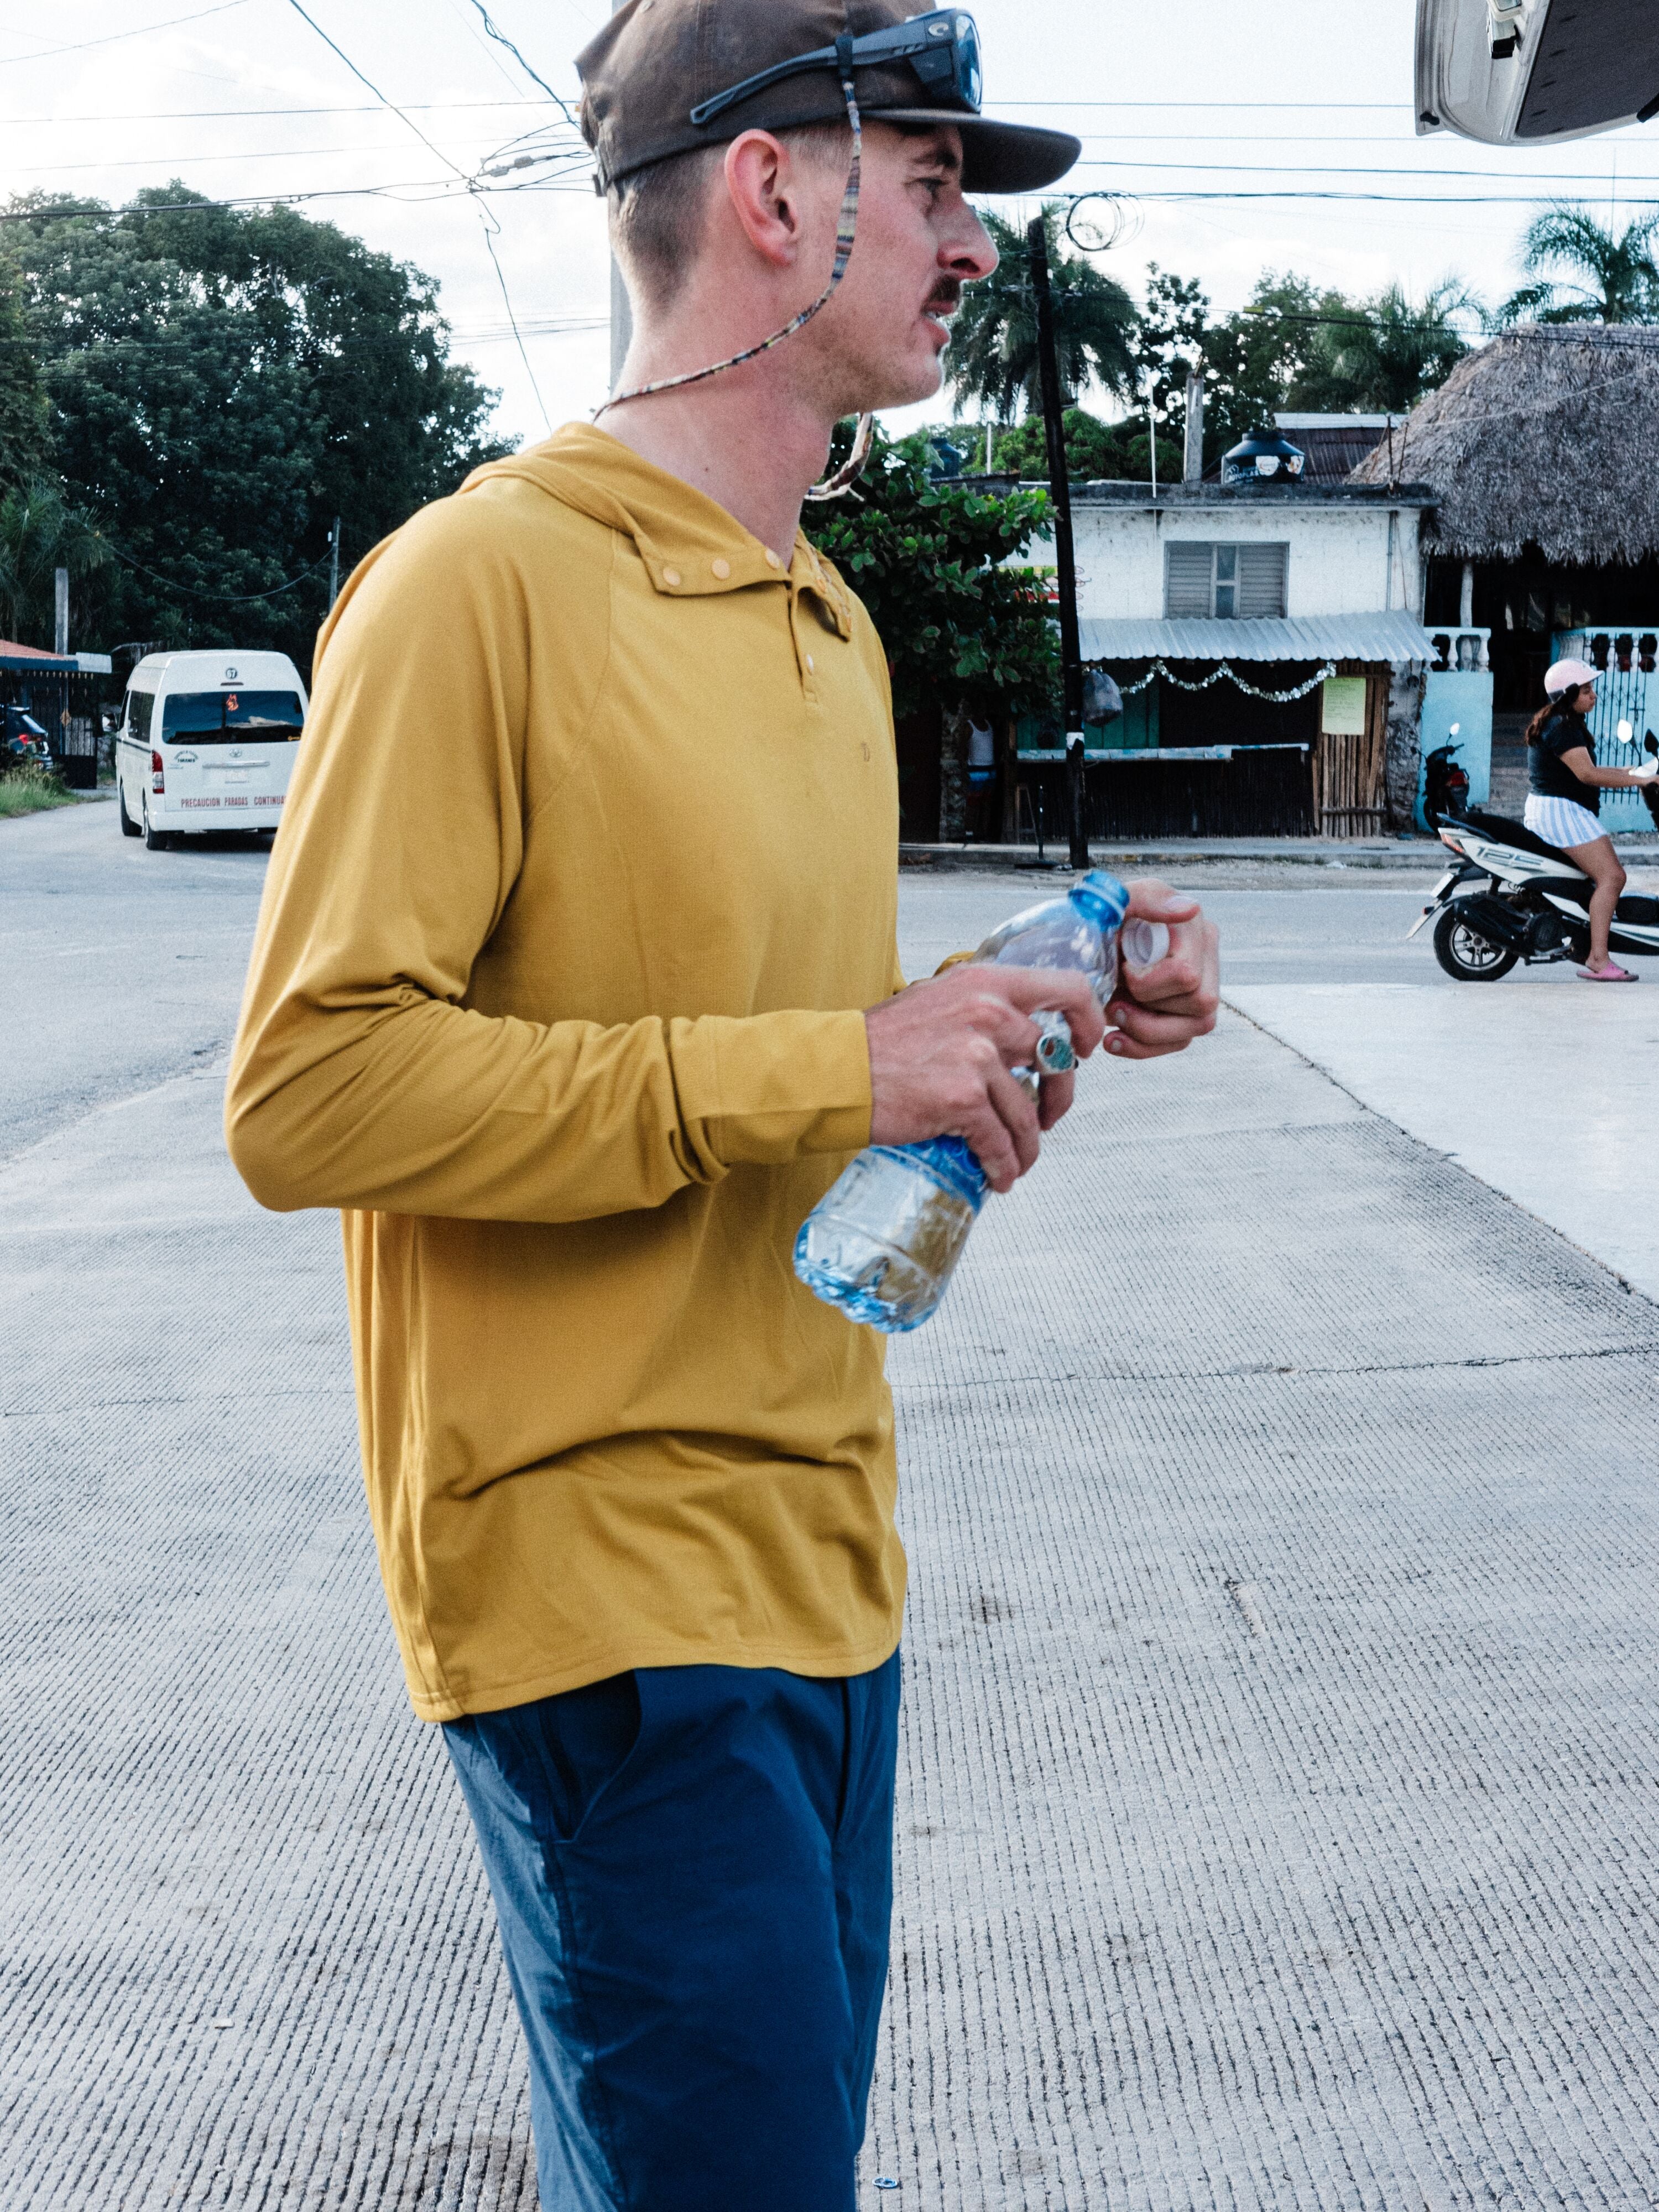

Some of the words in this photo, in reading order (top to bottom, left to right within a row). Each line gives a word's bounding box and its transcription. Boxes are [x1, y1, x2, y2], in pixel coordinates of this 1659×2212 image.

[181, 797, 220, 808] PRECAUCION
[225, 796, 248, 806] PARADAS
[254, 796, 286, 806] CONTINUA
[1477, 847, 1546, 869] 125
